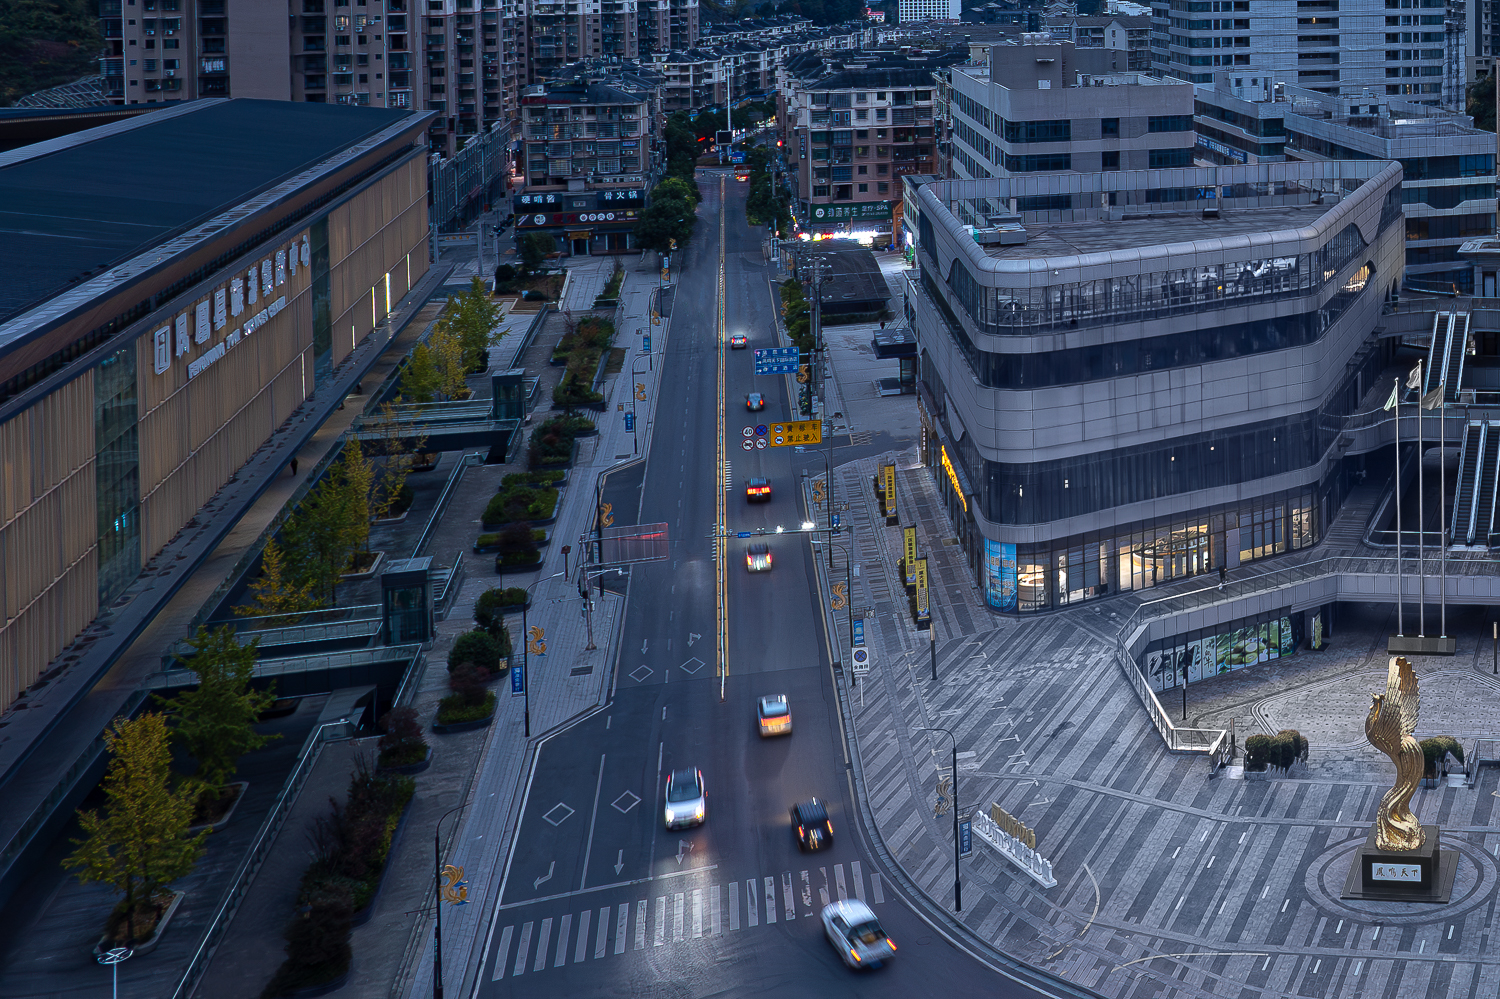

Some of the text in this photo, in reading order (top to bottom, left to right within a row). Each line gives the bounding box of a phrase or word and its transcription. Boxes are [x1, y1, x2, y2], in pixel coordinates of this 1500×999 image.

[744, 427, 753, 436] 40
[787, 433, 818, 442] 禁止驶入
[1375, 866, 1418, 878] 凤鸣天下
